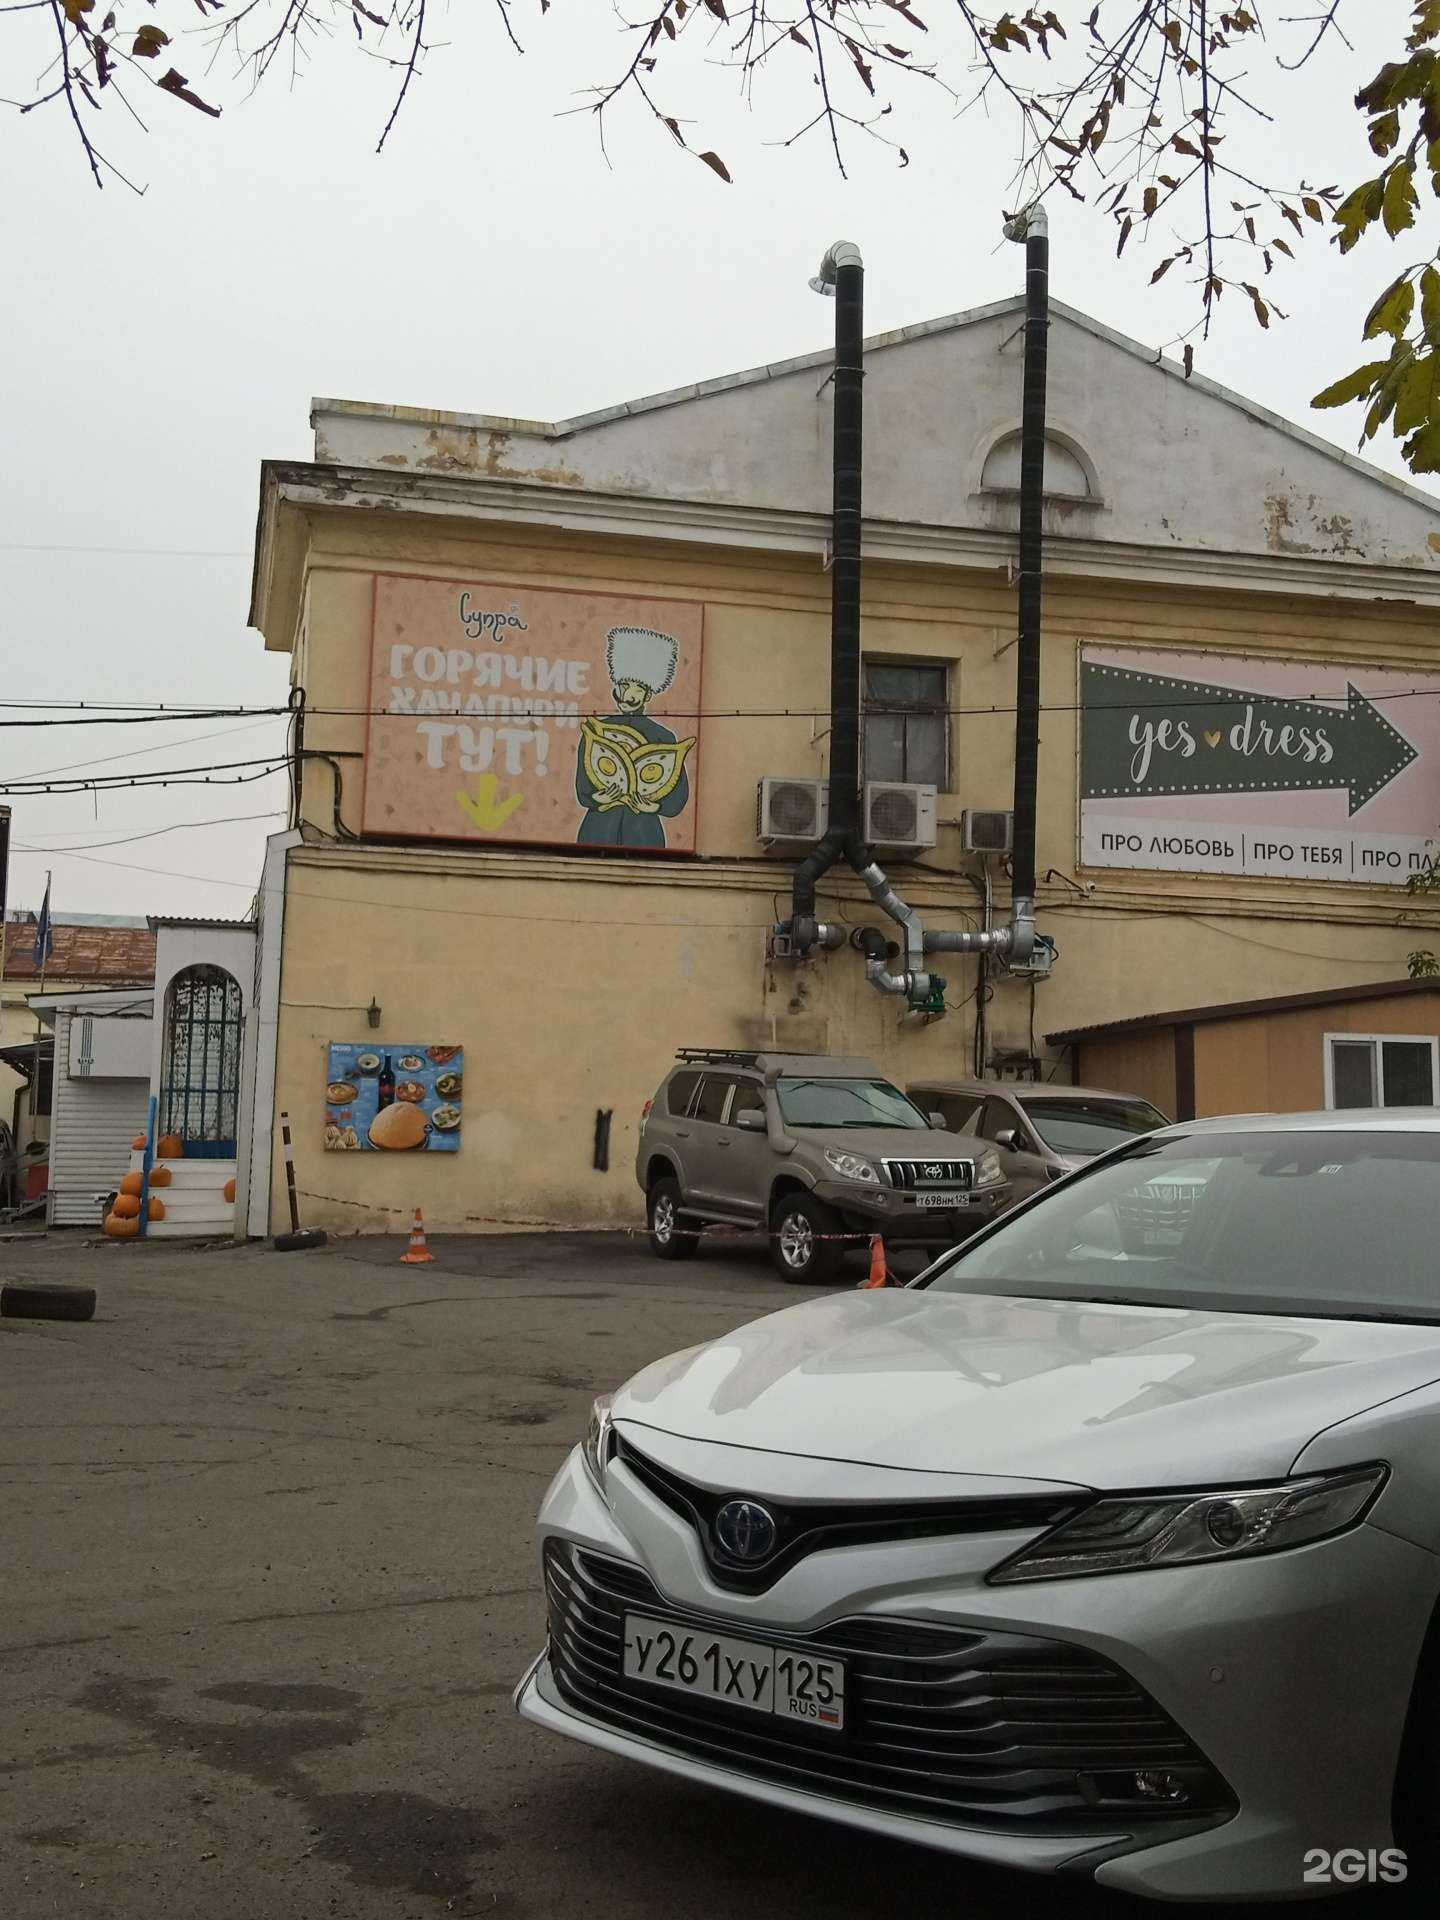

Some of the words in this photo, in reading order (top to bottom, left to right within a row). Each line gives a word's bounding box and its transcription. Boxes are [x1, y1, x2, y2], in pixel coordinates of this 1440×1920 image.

[390, 644, 591, 695] ГОРЯЧИЕ
[390, 687, 579, 728] ХАЧАПУРИ
[417, 722, 550, 776] ТУТ!
[1128, 714, 1197, 784] yes
[1230, 705, 1334, 764] dress
[1101, 834, 1142, 853] ПРО
[1149, 837, 1234, 857] ЛЮБОВЬ
[1253, 843, 1295, 862] ПРО
[1302, 846, 1343, 865] ТЕБЯ
[1362, 849, 1402, 868] ПРО
[778, 1656, 834, 1704] 125
[789, 1698, 817, 1717] RUS
